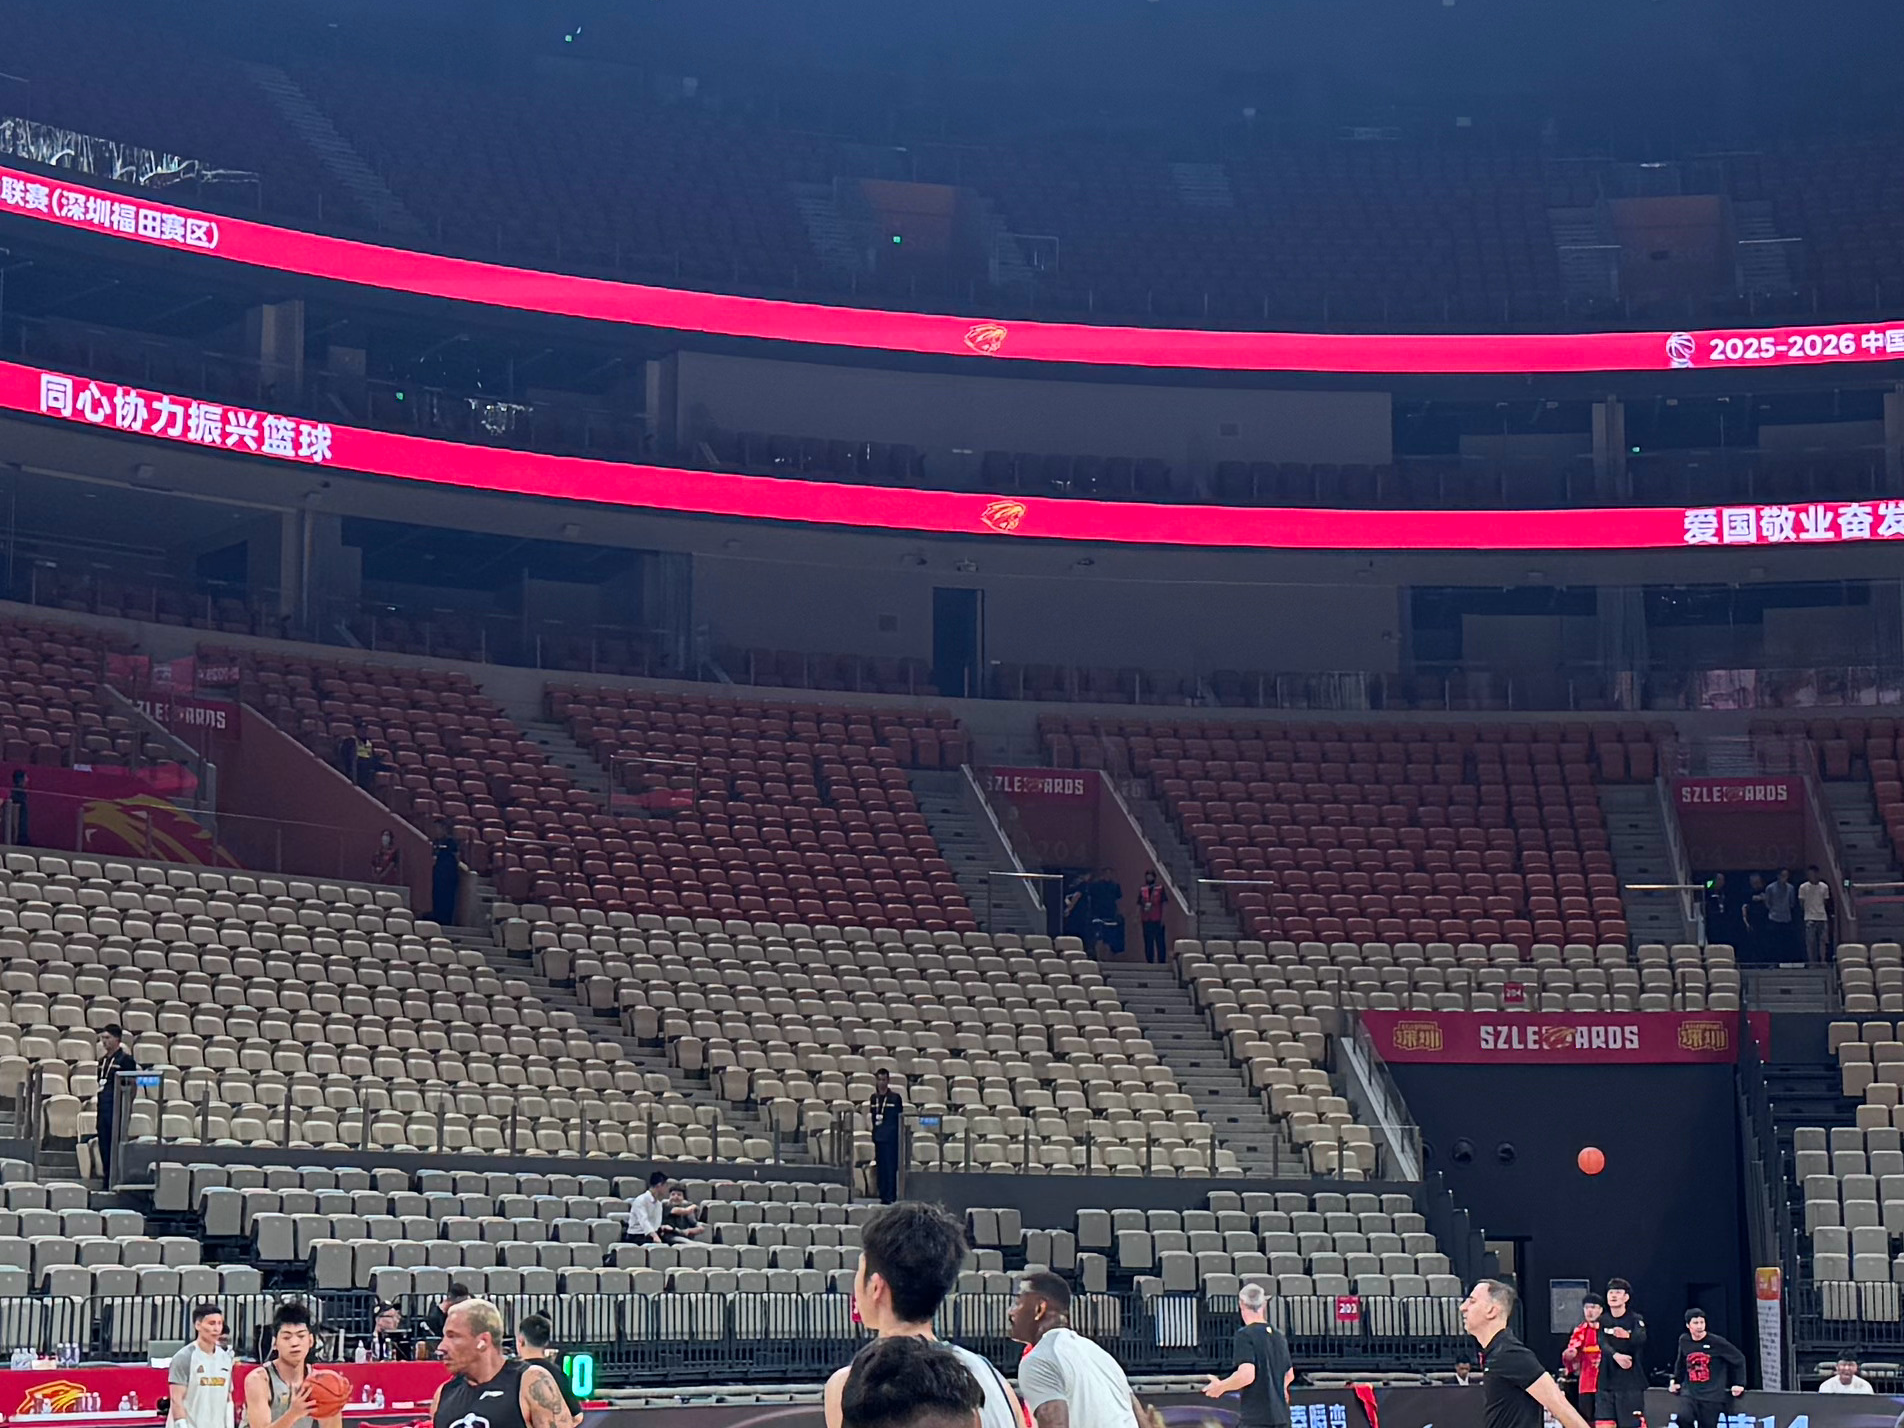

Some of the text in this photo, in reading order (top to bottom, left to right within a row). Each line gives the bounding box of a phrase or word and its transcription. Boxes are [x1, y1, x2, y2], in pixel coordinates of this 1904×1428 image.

[1710, 331, 1855, 361] 2025-2026
[39, 370, 332, 464] 同心协力振兴篮球
